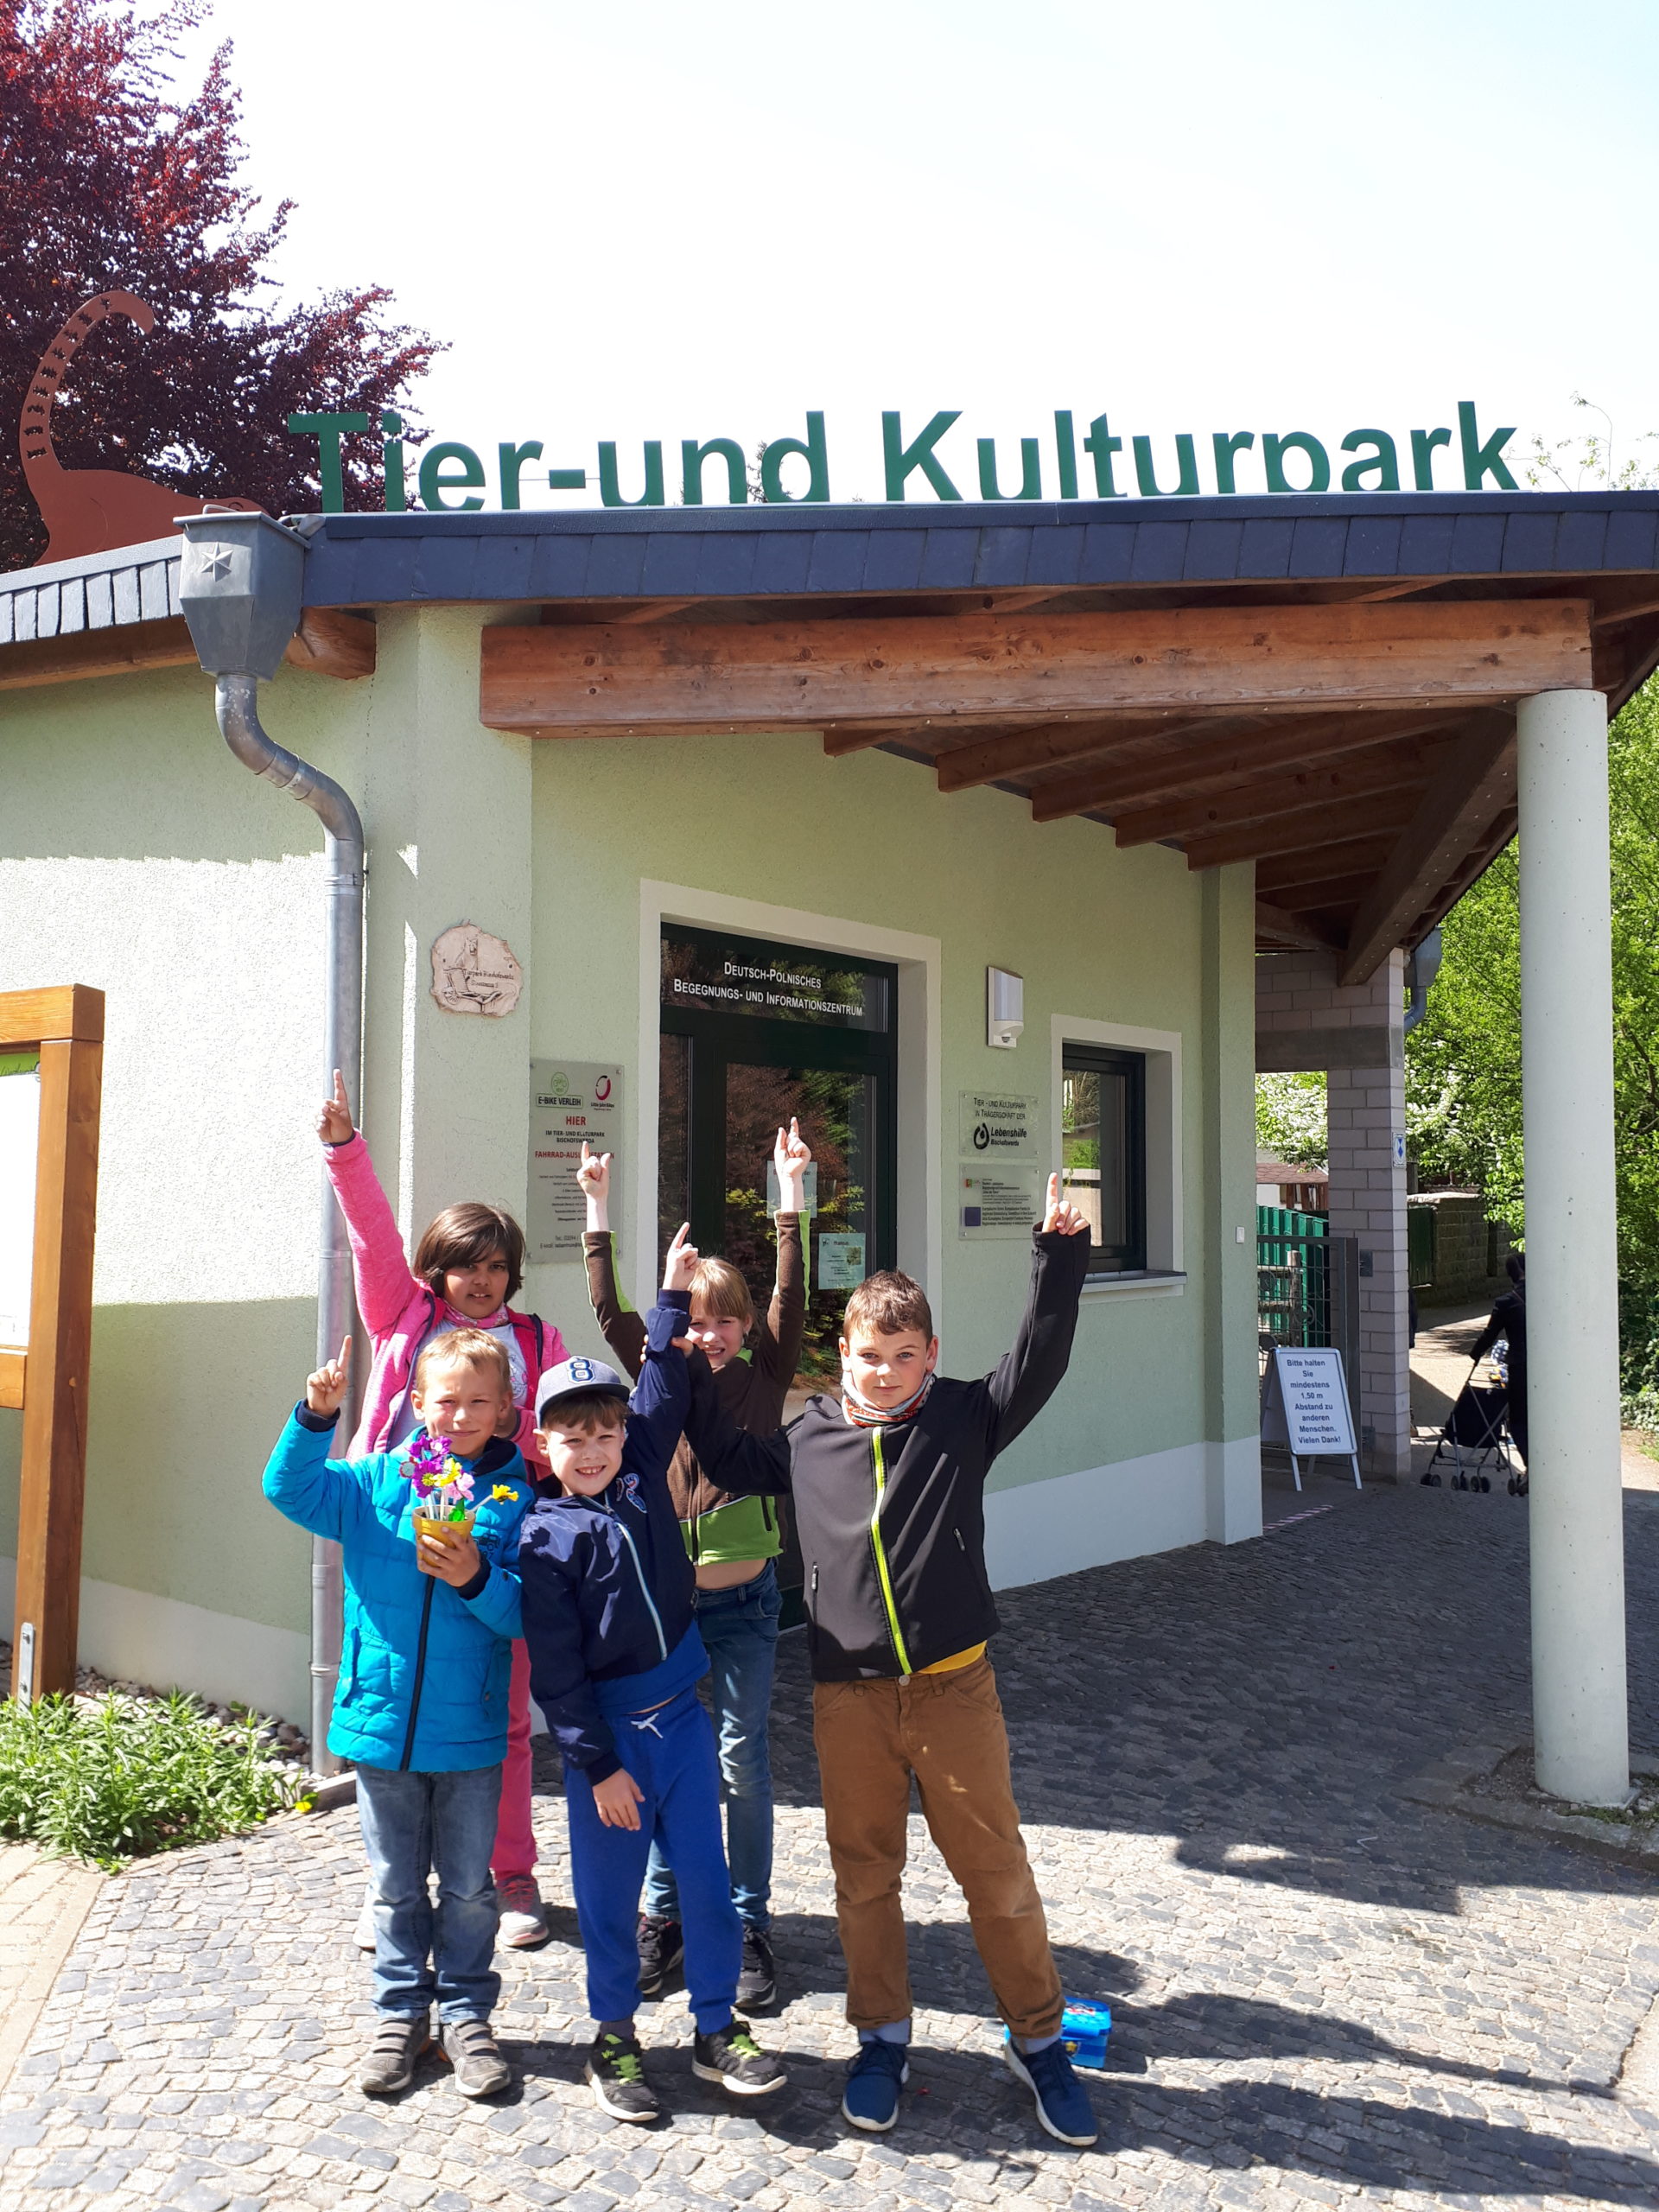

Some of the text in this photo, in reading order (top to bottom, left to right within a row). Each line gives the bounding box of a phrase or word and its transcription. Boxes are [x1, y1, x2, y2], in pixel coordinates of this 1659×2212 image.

[881, 400, 1520, 503] Kulturpark
[746, 990, 764, 1003] UND
[537, 1096, 557, 1105] E-BIKE
[974, 1097, 985, 1106] TIER
[566, 1116, 587, 1126] HIER
[990, 1127, 1027, 1138] Lebenshilfe
[569, 1357, 594, 1382] 8
